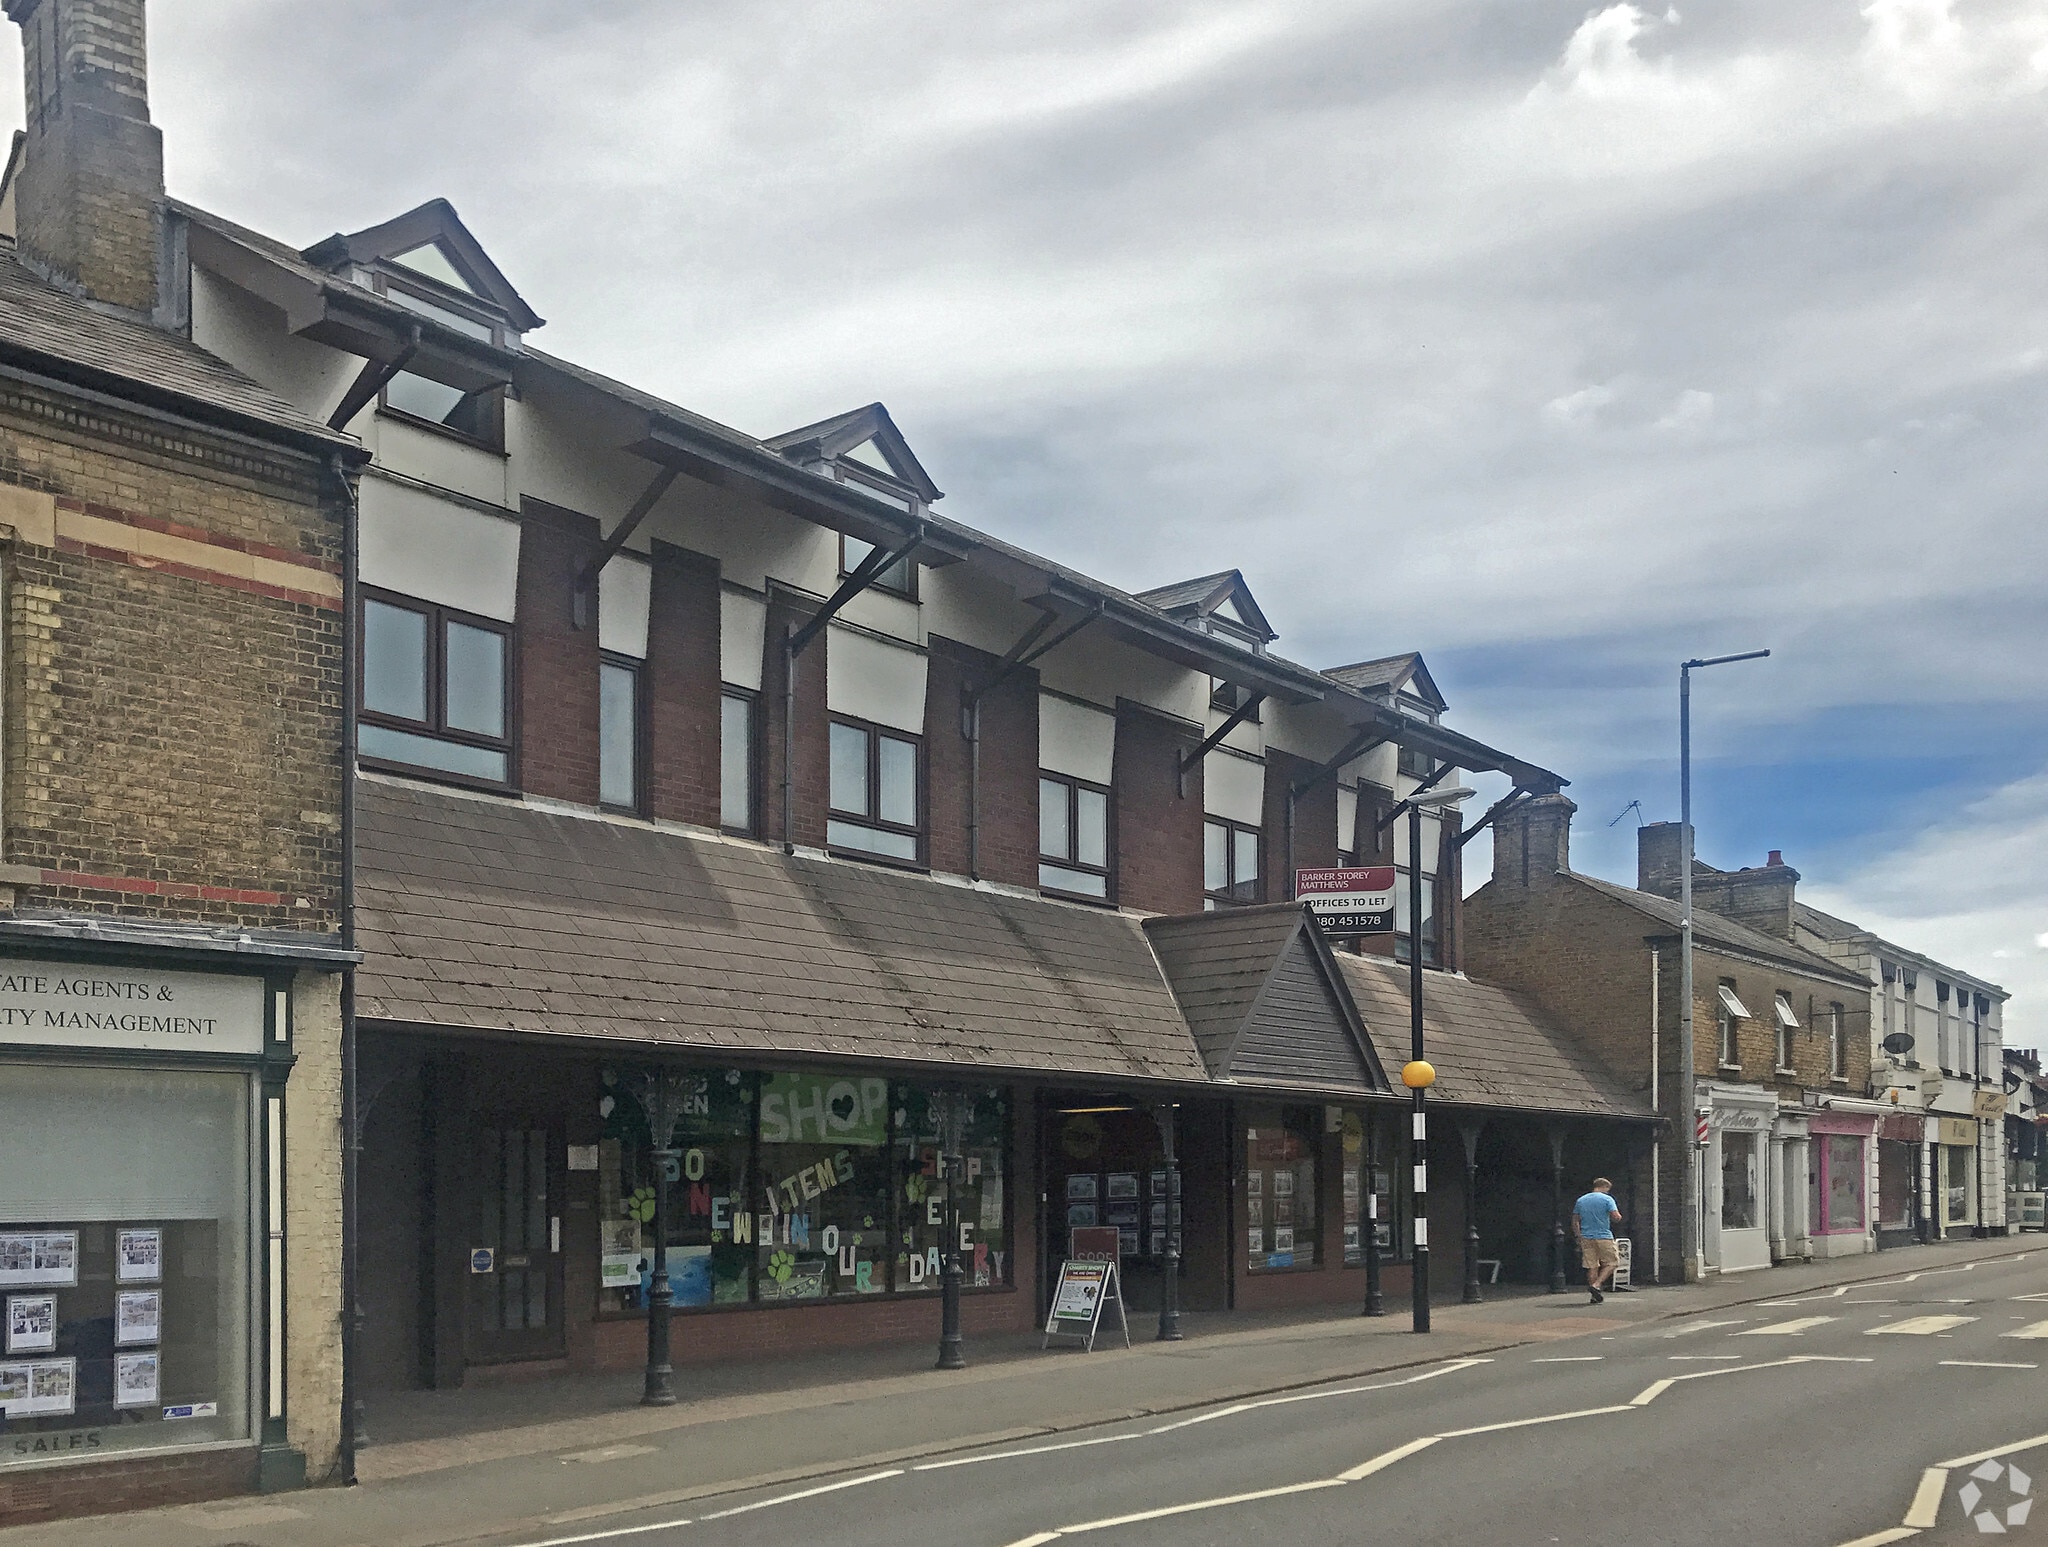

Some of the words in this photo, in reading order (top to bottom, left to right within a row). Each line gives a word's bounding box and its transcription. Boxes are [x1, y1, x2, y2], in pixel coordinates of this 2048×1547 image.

[1300, 880, 1349, 889] MATTHEWS
[1301, 873, 1335, 881] BARKER
[1337, 871, 1370, 880] STOREY
[1310, 899, 1349, 908] OFFICES
[1352, 898, 1366, 906] TO
[1368, 897, 1386, 906] LET
[1338, 915, 1381, 926] 451578
[54, 978, 149, 1001] AGENTS
[156, 984, 174, 1002] &
[0, 1008, 36, 1027] TY
[44, 1009, 217, 1035] MANAGEMENT
[759, 1077, 888, 1143] SHOP
[690, 1183, 752, 1244] NEW
[765, 1150, 855, 1216] ITEMS
[783, 1213, 809, 1245] IN
[822, 1224, 873, 1292] OUR
[14, 1431, 101, 1456] SALES
